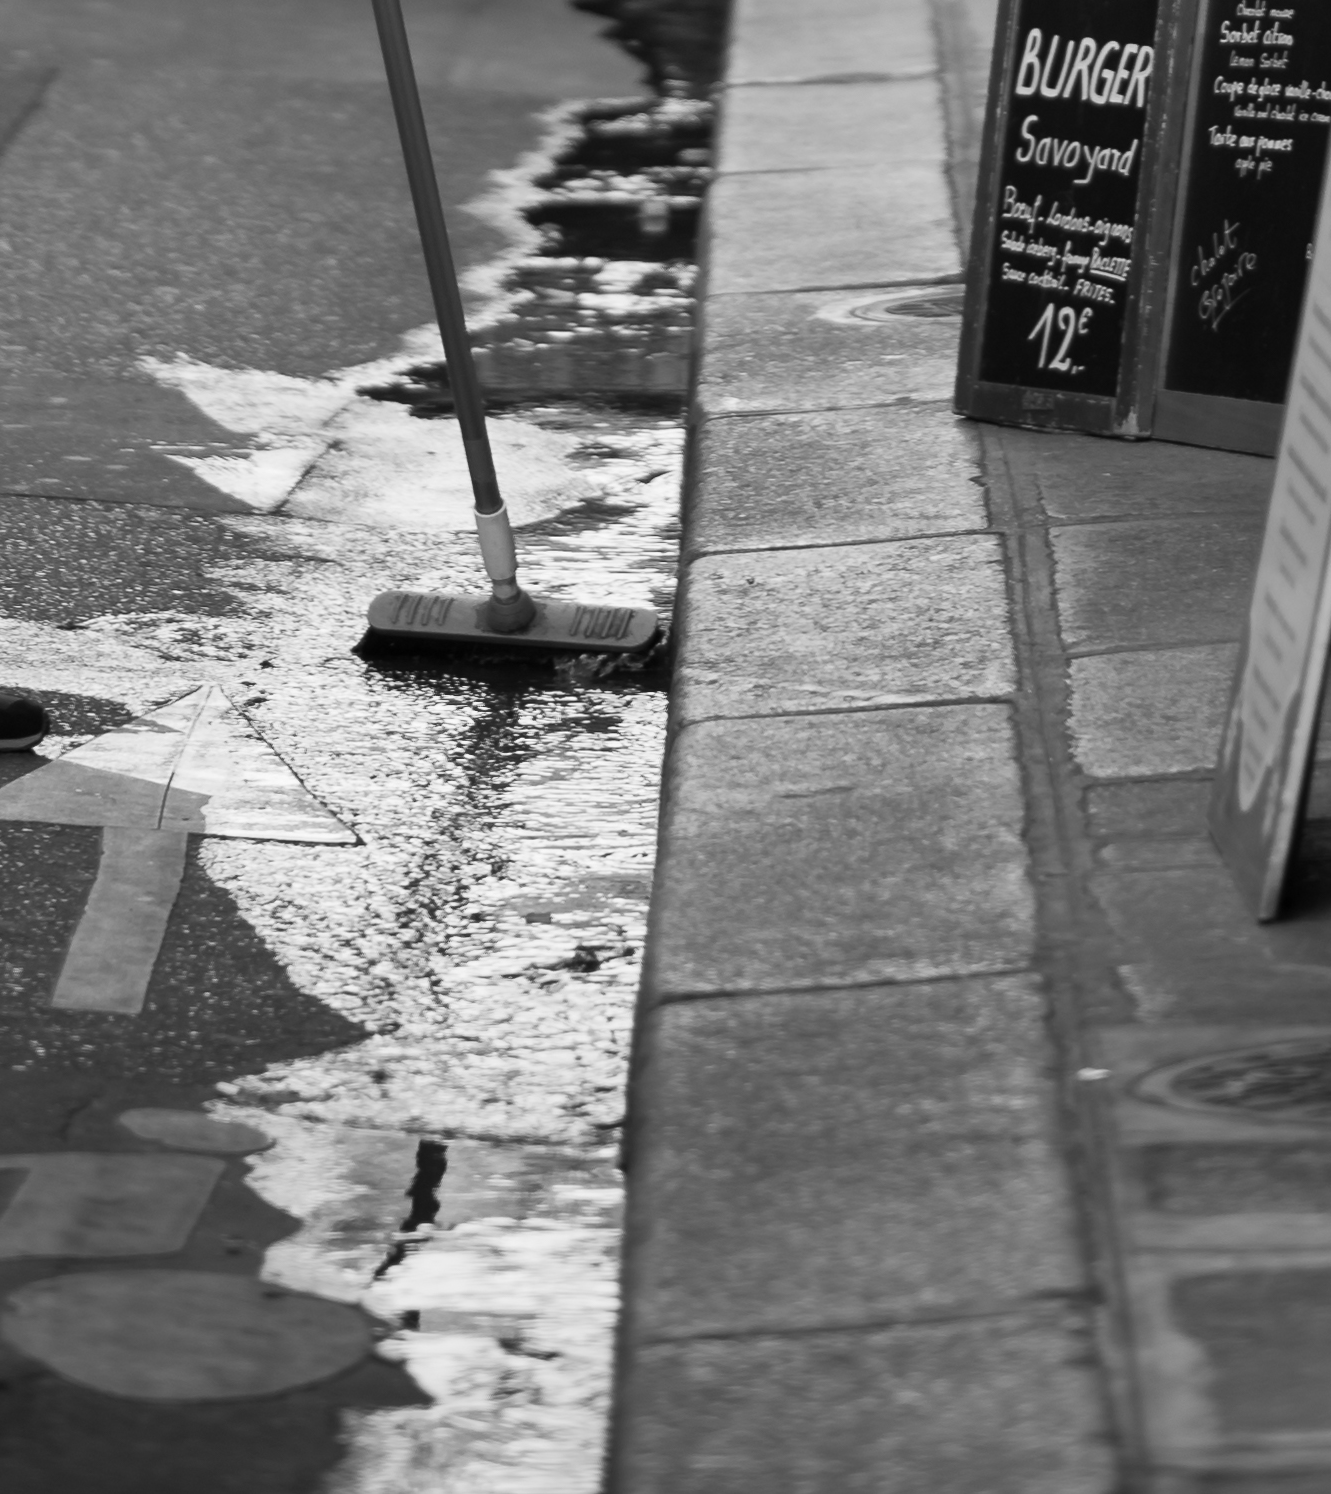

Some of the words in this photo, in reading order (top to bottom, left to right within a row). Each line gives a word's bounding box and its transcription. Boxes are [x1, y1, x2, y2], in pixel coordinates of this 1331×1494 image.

[1219, 20, 1261, 43] Sorbet
[1015, 28, 1154, 108] BURGER
[1214, 76, 1245, 102] Coupe
[1247, 77, 1259, 94] de
[1209, 125, 1237, 146] Tarte
[1016, 115, 1139, 184] Savoyard
